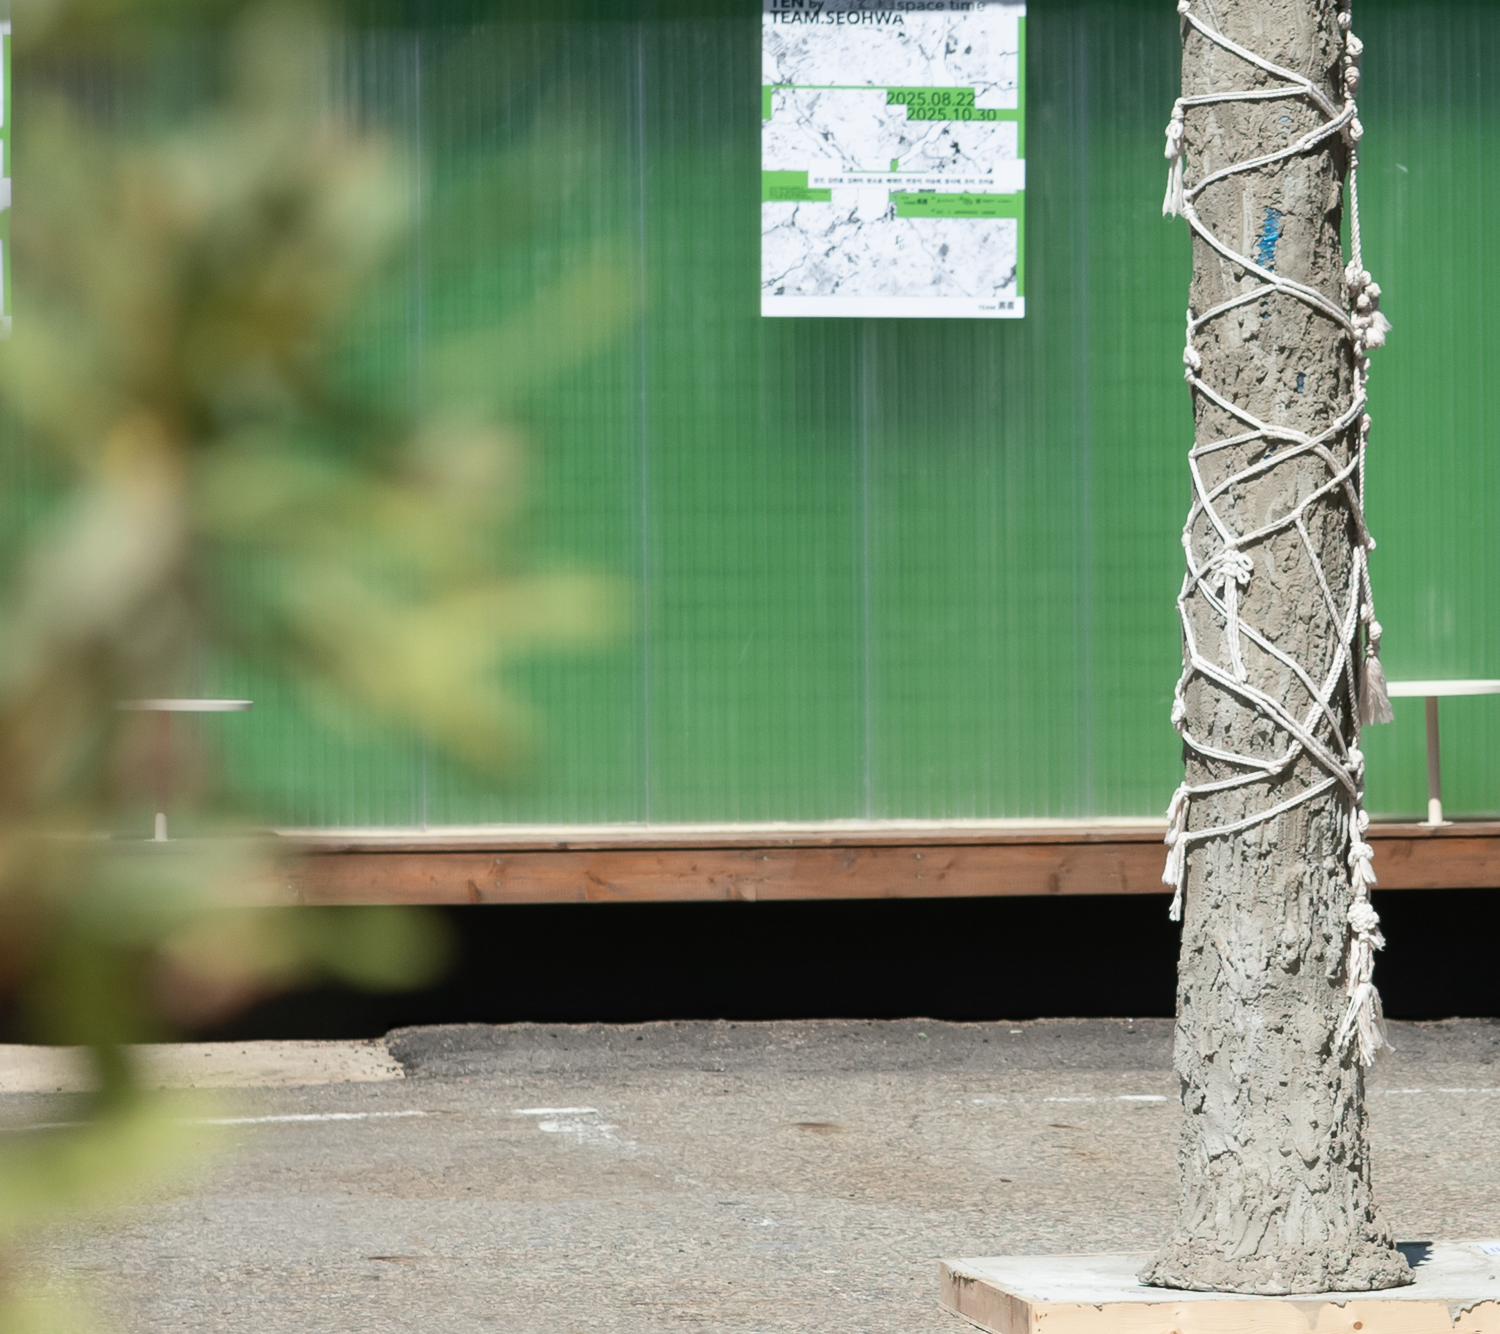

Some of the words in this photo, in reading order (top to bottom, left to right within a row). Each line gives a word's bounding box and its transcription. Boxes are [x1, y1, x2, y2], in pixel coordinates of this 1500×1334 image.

[897, 0, 946, 13] space
[770, 10, 904, 26] TEAM.SEOHWA
[886, 91, 975, 107] 2025.08.22
[907, 107, 997, 121] 2025.10.30
